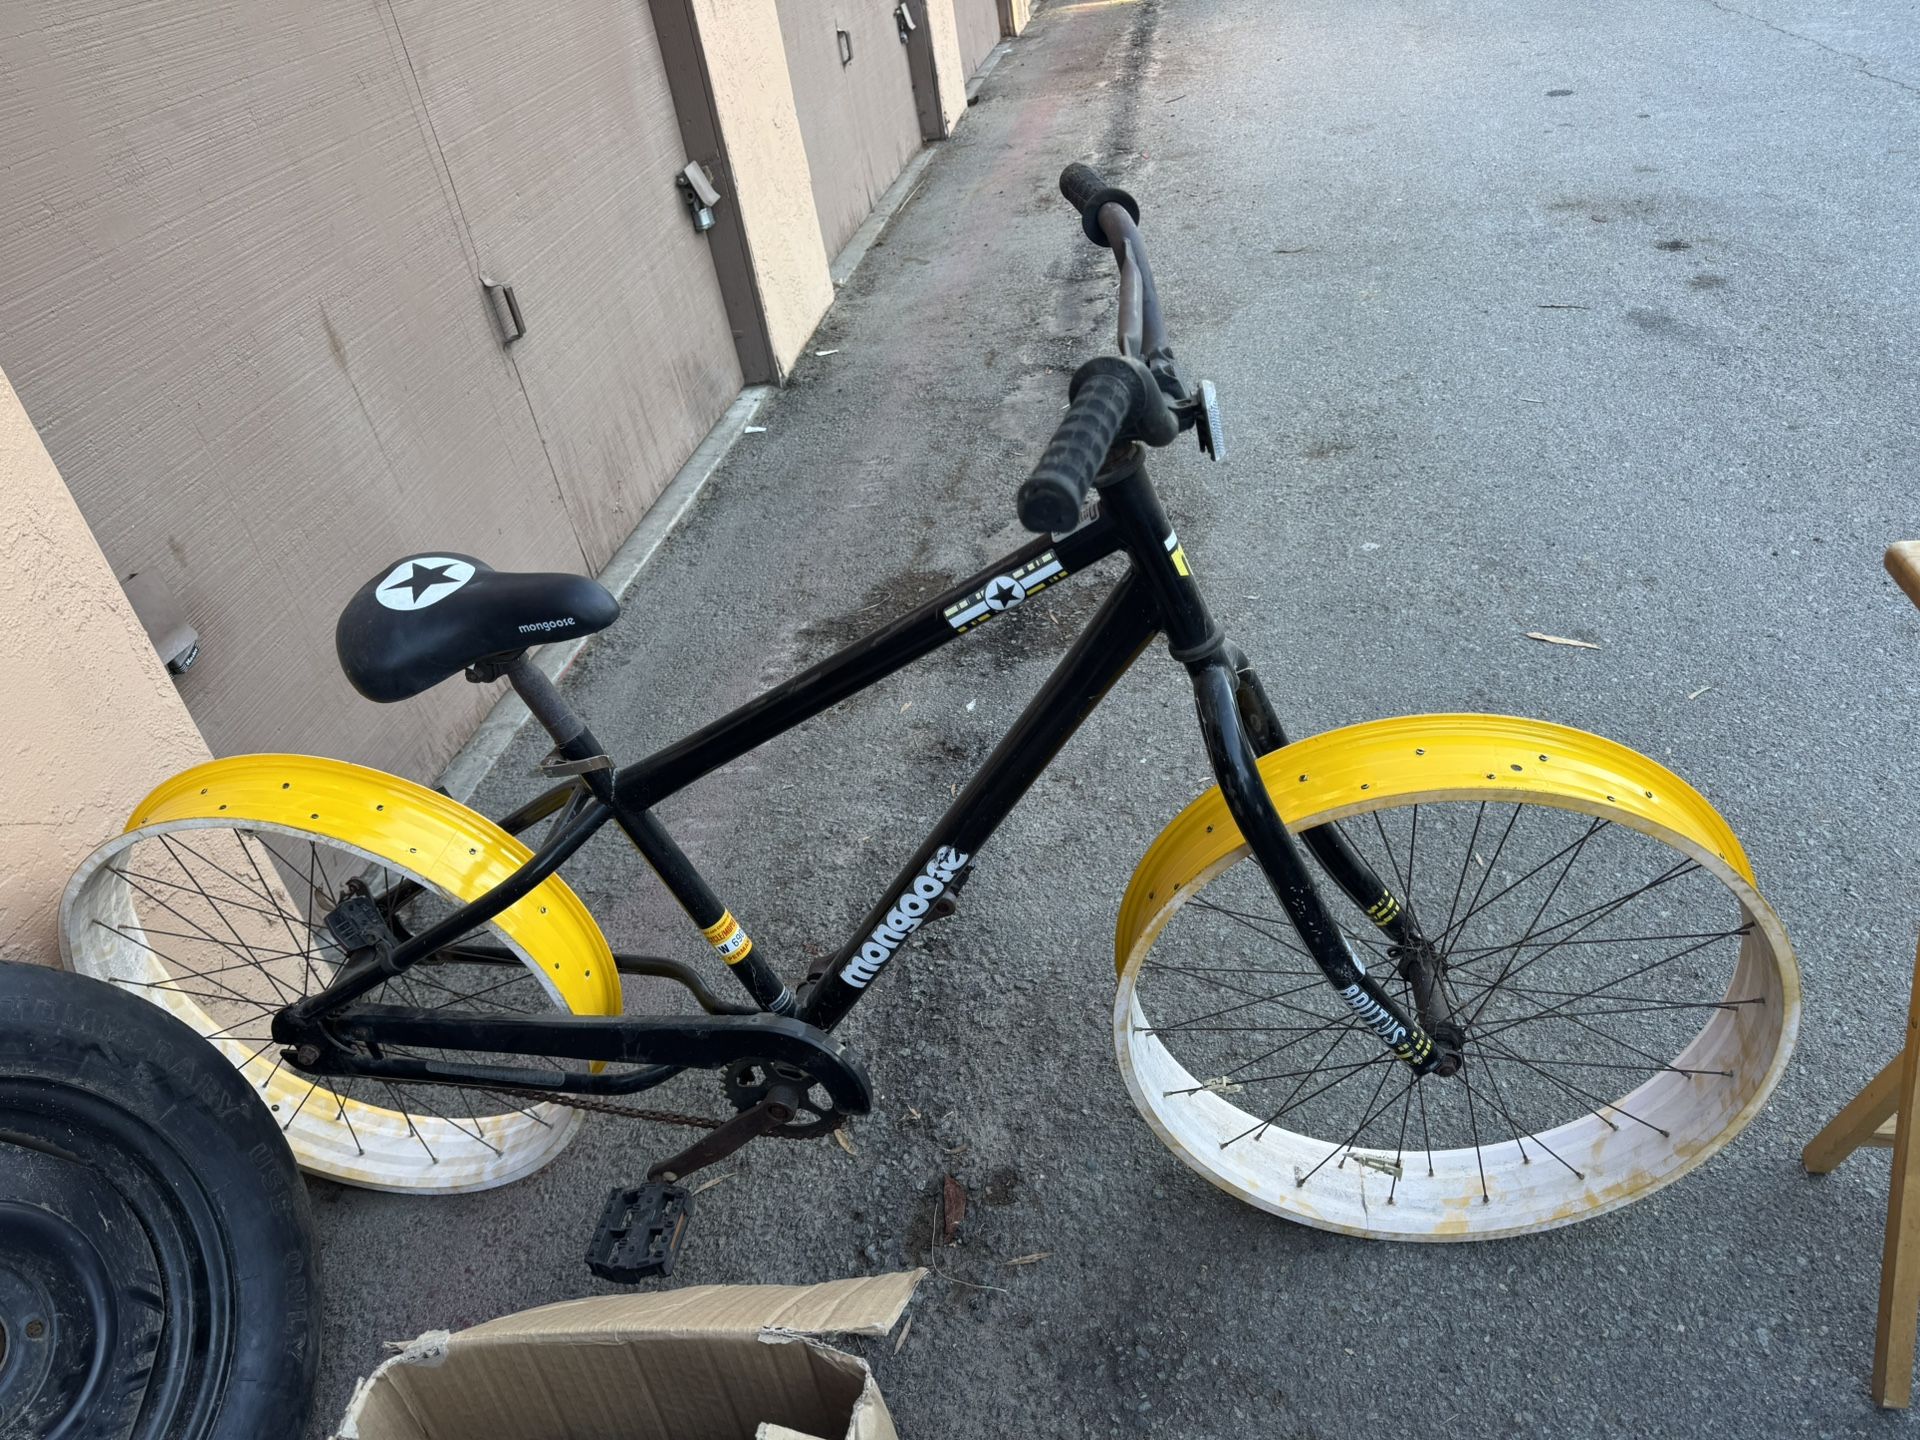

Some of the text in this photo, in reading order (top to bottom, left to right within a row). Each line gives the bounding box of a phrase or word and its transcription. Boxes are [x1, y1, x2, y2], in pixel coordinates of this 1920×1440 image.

[518, 617, 576, 634] mongoose
[840, 845, 969, 988] mongoose
[1339, 984, 1406, 1045] BRUTUS
